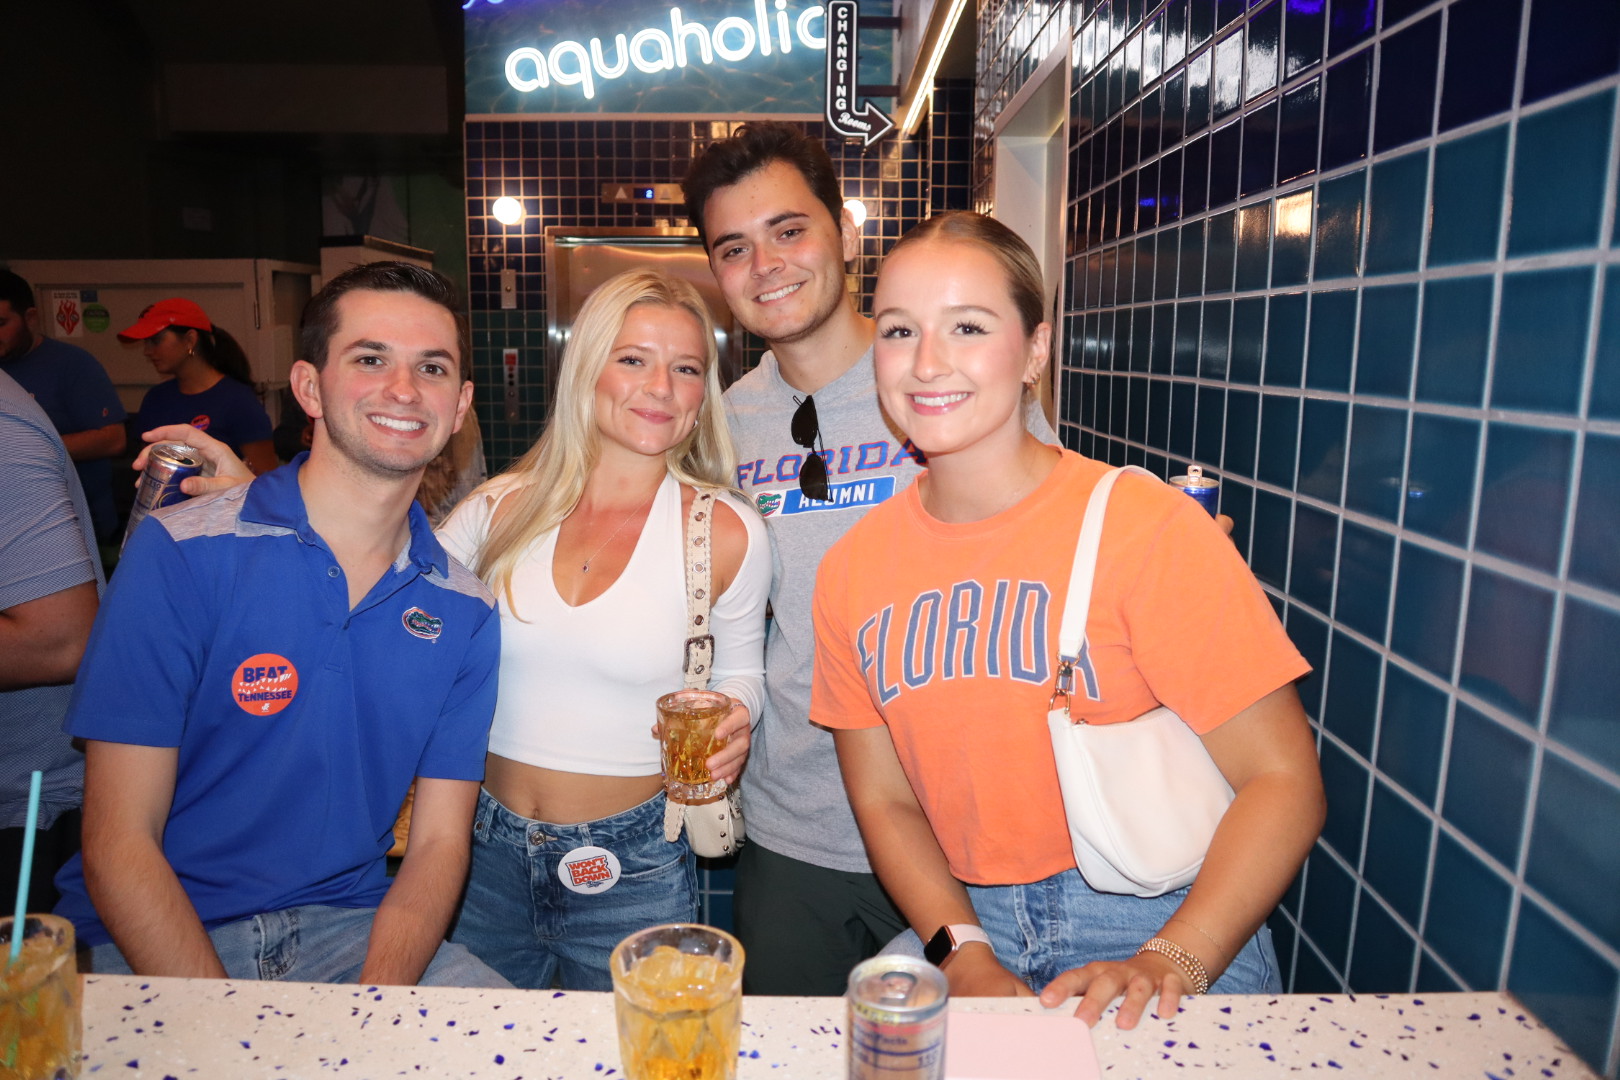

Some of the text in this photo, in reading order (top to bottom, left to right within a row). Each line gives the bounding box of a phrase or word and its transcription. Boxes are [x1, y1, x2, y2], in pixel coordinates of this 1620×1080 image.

[504, 0, 828, 99] aquaholic
[835, 6, 848, 110] CHANGING
[838, 112, 872, 132] Rooms
[645, 189, 653, 199] 2
[737, 438, 929, 489] FLORIDA
[243, 666, 288, 683] BEAT
[238, 690, 293, 702] TENNESSEE
[571, 864, 608, 878] BACK
[574, 872, 611, 885] DOWN
